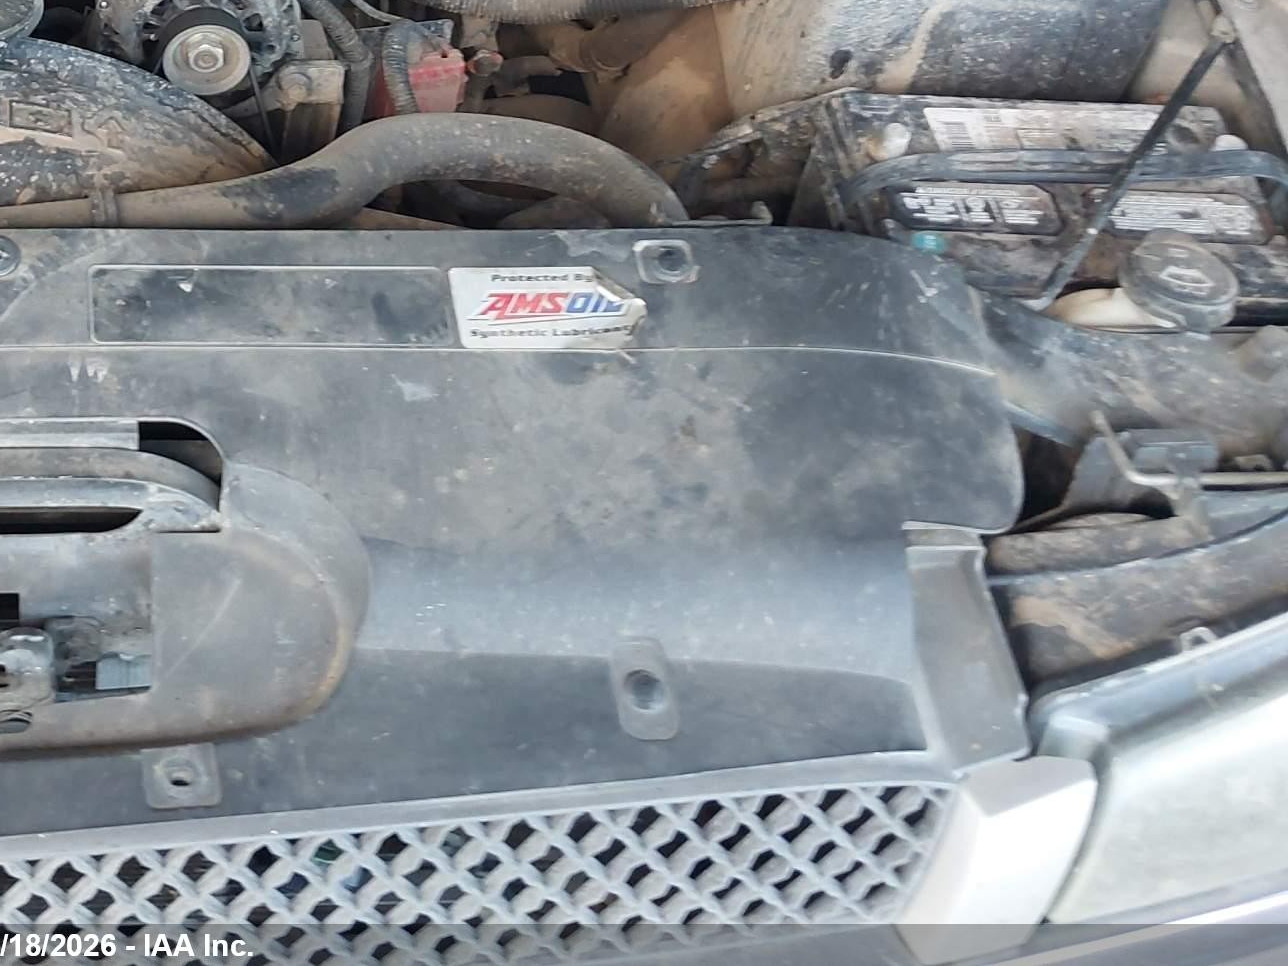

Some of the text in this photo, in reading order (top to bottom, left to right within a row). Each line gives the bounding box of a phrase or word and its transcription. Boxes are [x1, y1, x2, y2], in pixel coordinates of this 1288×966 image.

[491, 273, 569, 282] Protected
[478, 292, 626, 320] AMSOIL
[471, 328, 546, 339] Synthetic
